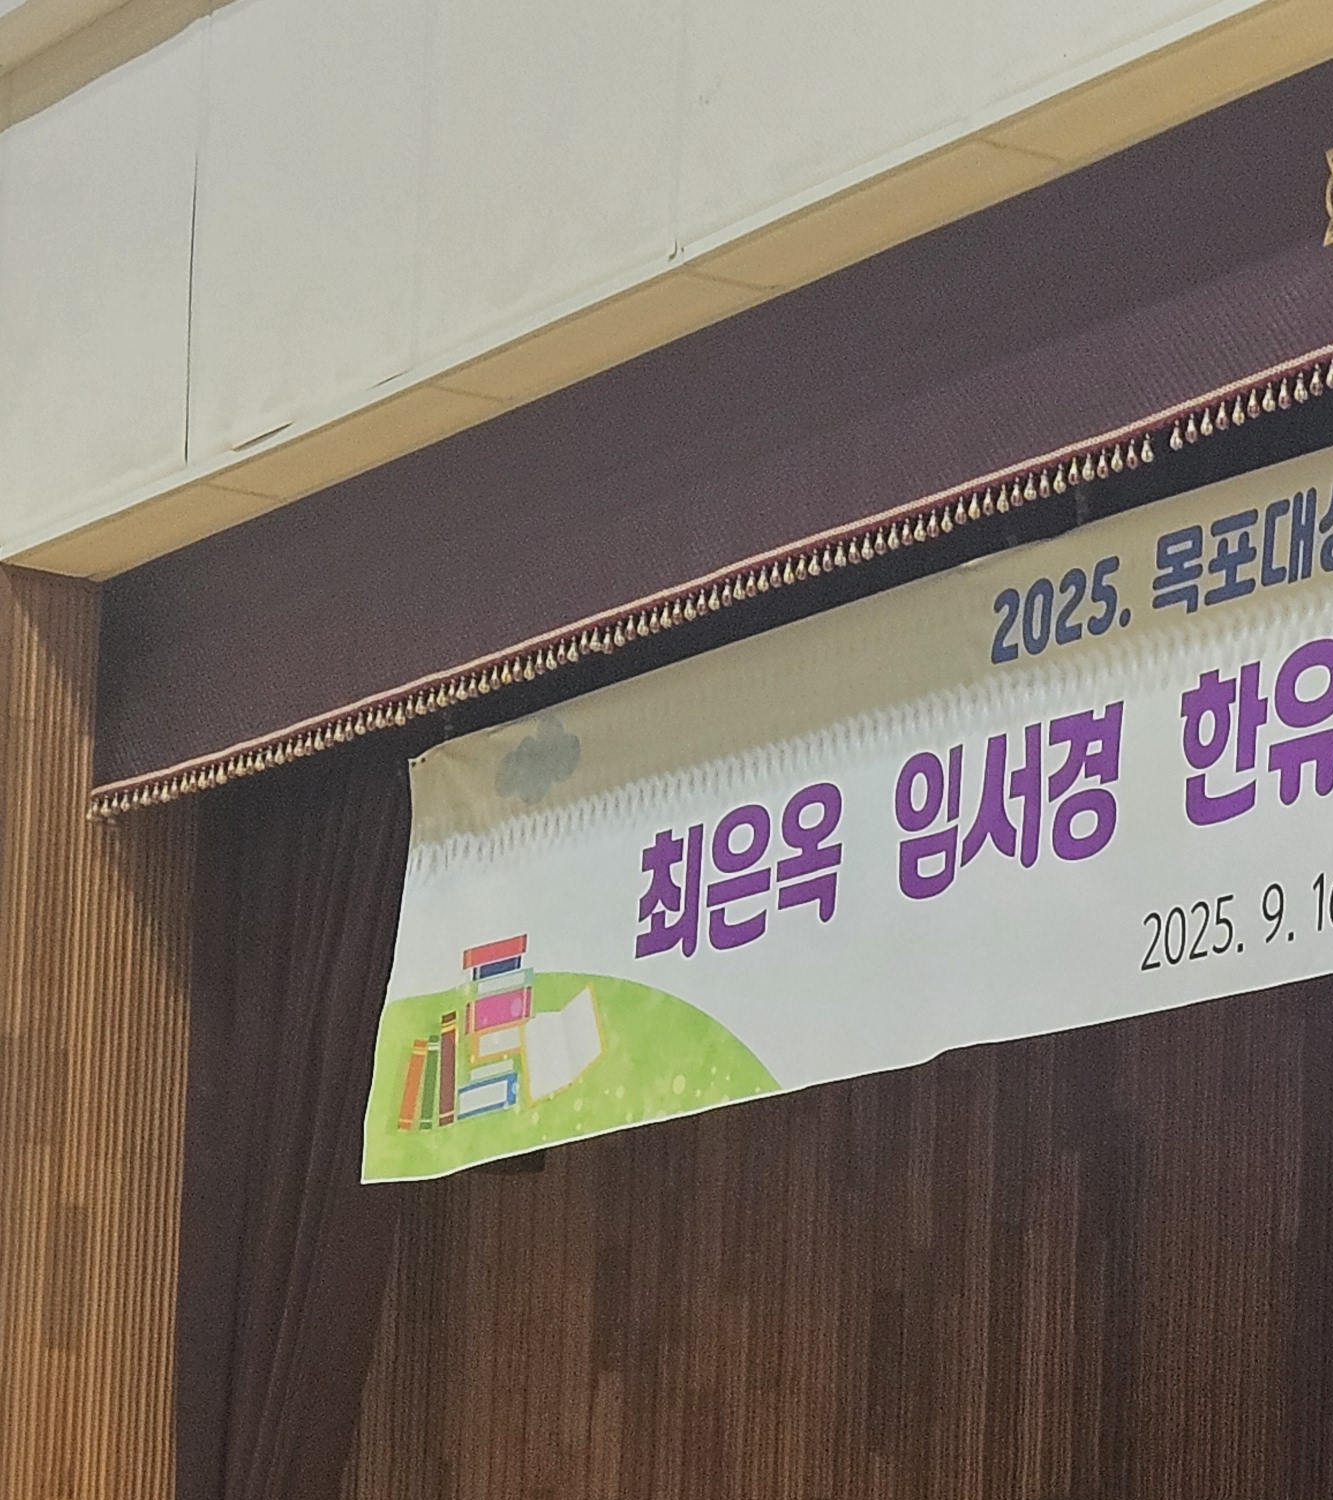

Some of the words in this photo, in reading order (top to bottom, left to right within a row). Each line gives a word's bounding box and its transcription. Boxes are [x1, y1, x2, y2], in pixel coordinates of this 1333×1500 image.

[990, 555, 1132, 665] 2025.
[634, 782, 844, 960] 최은옥
[894, 701, 1126, 901] 임서경
[1140, 893, 1245, 972] 2025.
[1261, 883, 1296, 944] 9.
